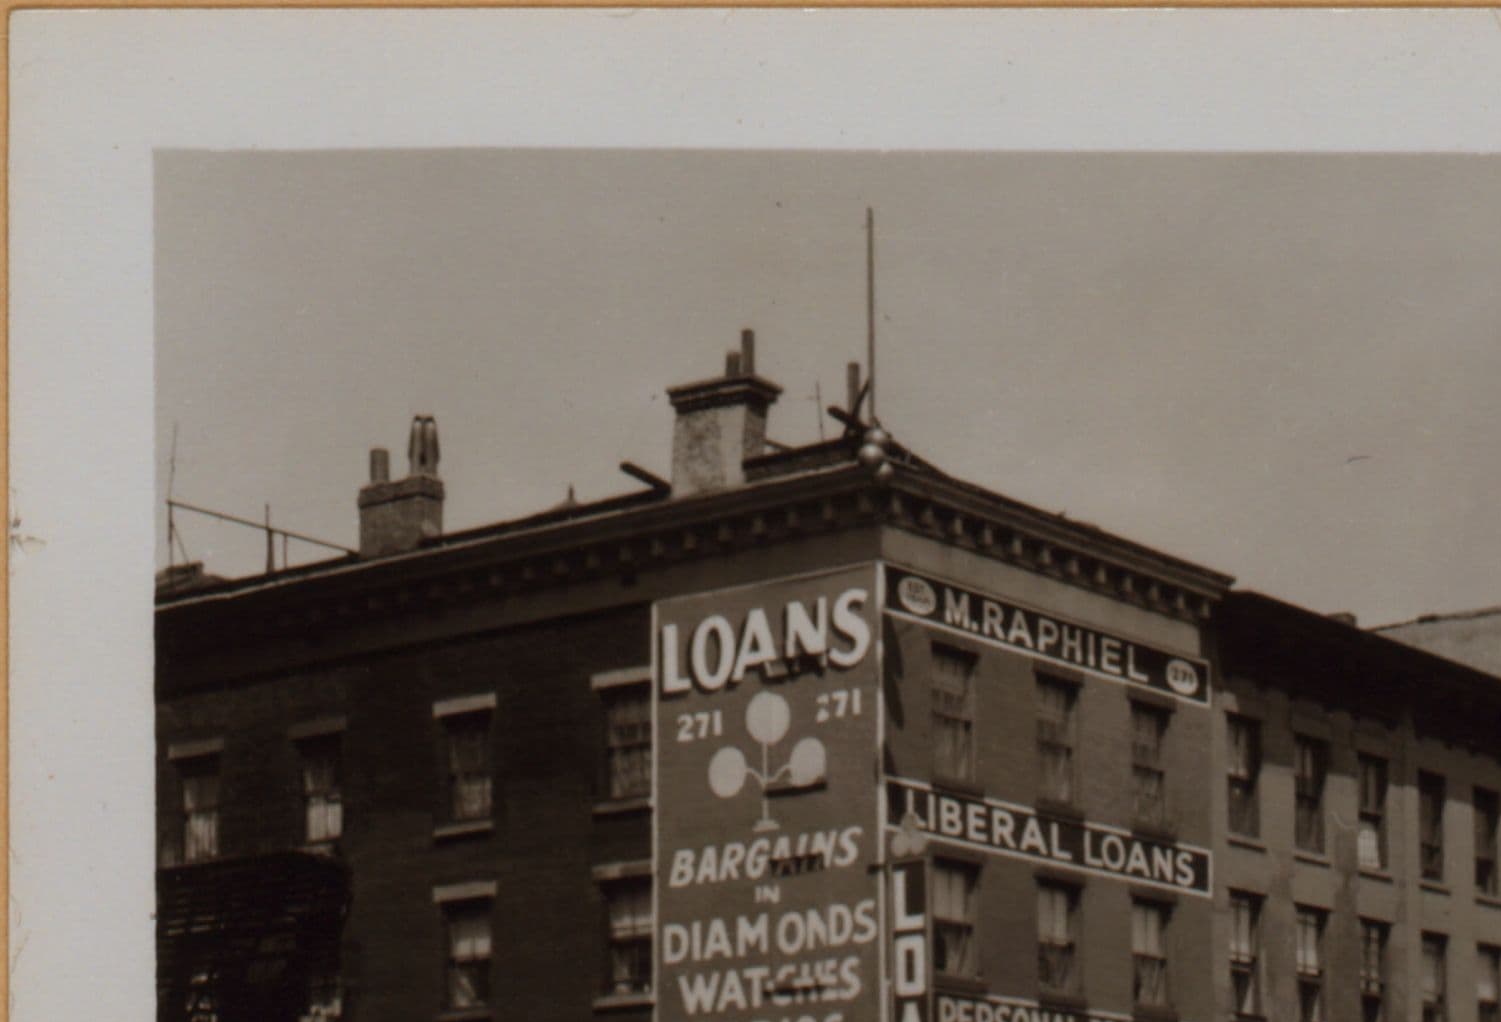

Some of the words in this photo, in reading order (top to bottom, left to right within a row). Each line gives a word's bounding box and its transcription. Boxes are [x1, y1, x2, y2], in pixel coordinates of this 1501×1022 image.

[661, 589, 871, 692] LOANS
[676, 711, 722, 742] 271
[817, 692, 861, 722] 271
[670, 827, 862, 887] BARGAINS
[905, 791, 1073, 861] LIBERAL
[1084, 825, 1195, 886] LOANS
[756, 886, 780, 903] IN
